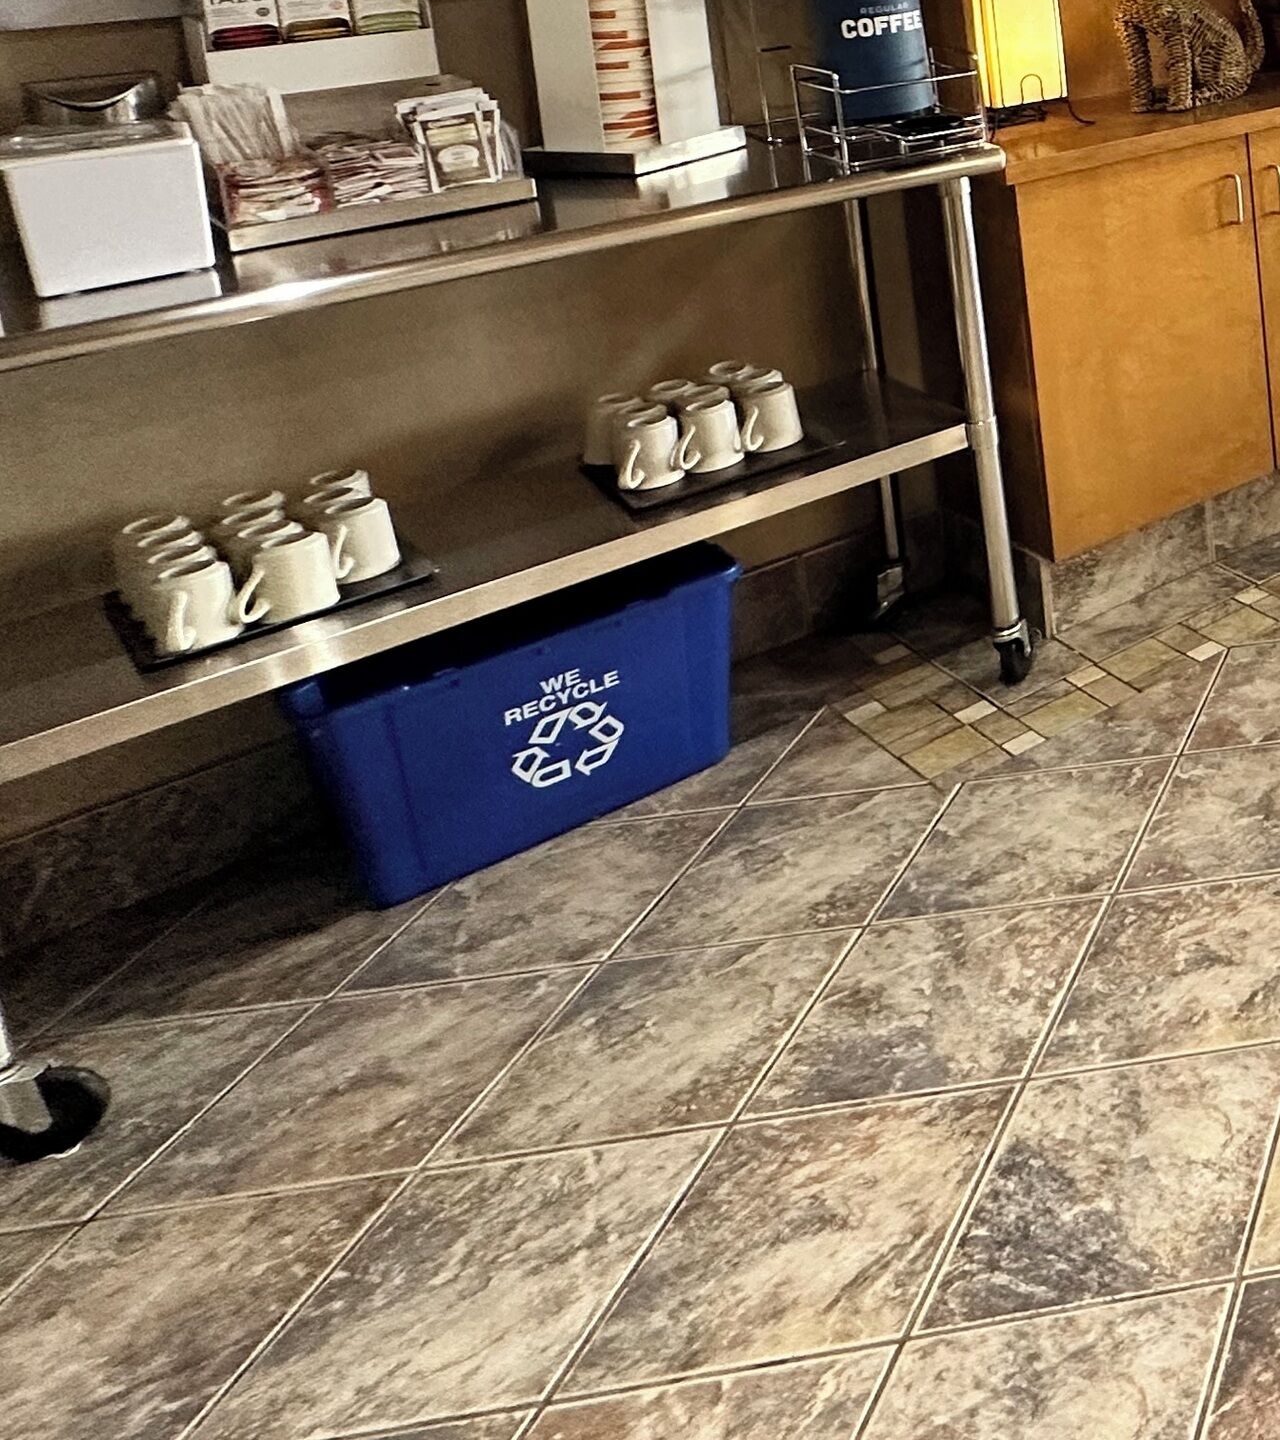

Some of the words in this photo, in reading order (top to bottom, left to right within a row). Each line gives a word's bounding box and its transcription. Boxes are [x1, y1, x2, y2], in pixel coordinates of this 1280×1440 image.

[860, 2, 909, 15] REGULAR
[841, 9, 923, 40] COFFEE
[539, 668, 582, 695] WE
[504, 670, 620, 727] RECYCLE
